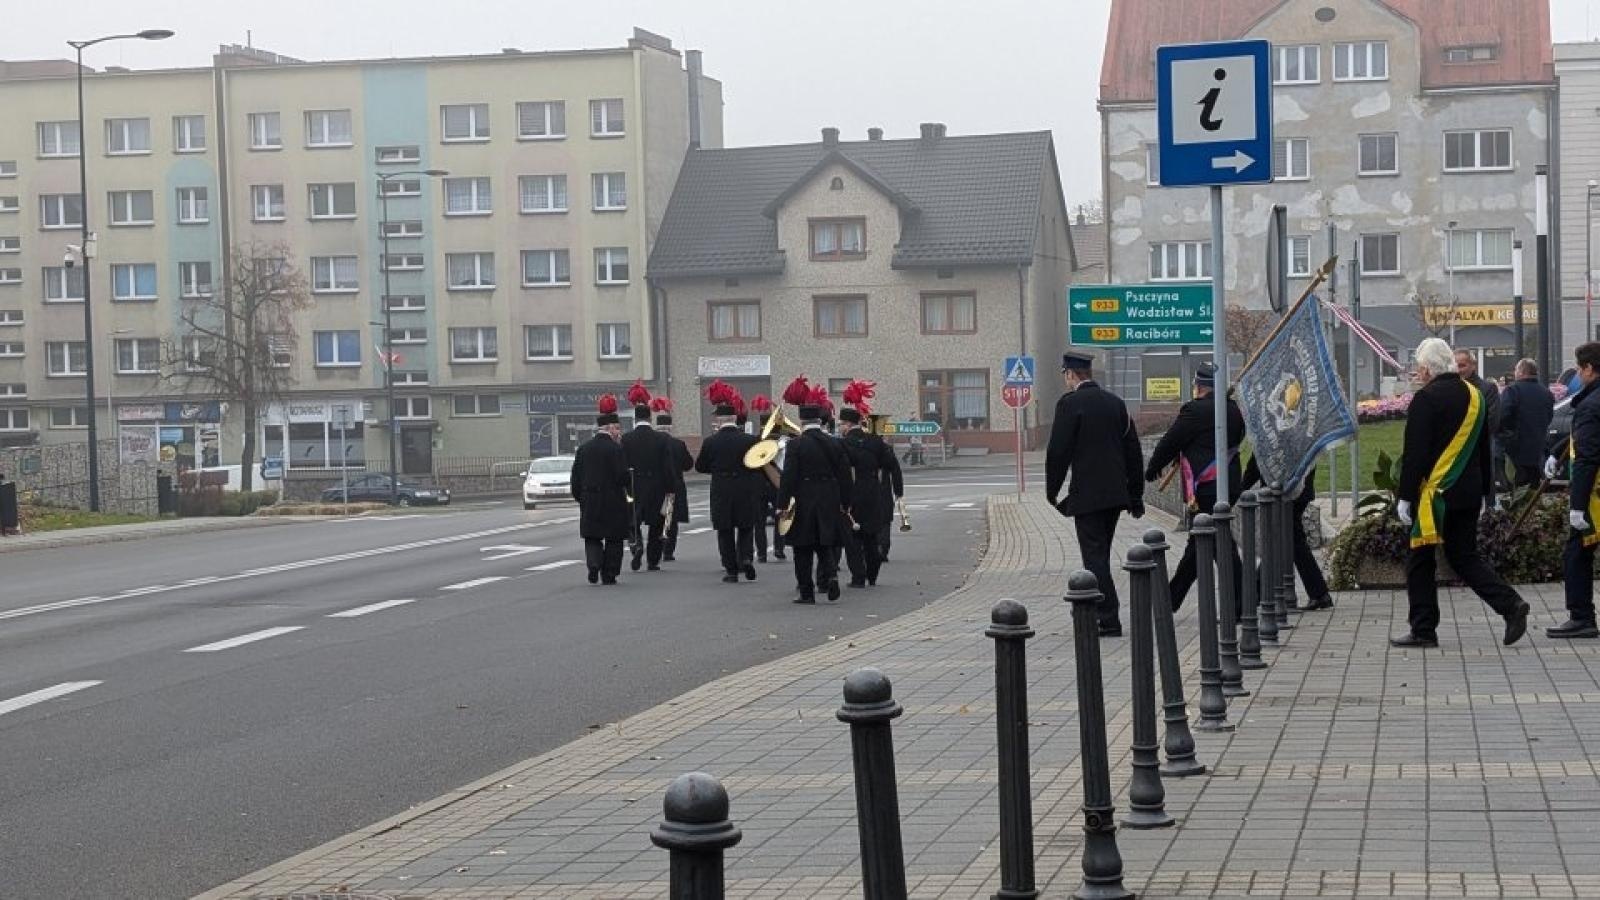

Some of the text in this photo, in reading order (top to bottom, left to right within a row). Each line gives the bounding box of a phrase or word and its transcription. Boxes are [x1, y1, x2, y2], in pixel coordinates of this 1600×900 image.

[1125, 290, 1179, 304] Pszczyna
[1095, 301, 1114, 309] 933
[1125, 306, 1194, 318] Wodzisław
[1429, 309, 1538, 321] ANTALYA KEAB
[1125, 326, 1181, 339] Racibórz
[1004, 388, 1029, 400] STOP
